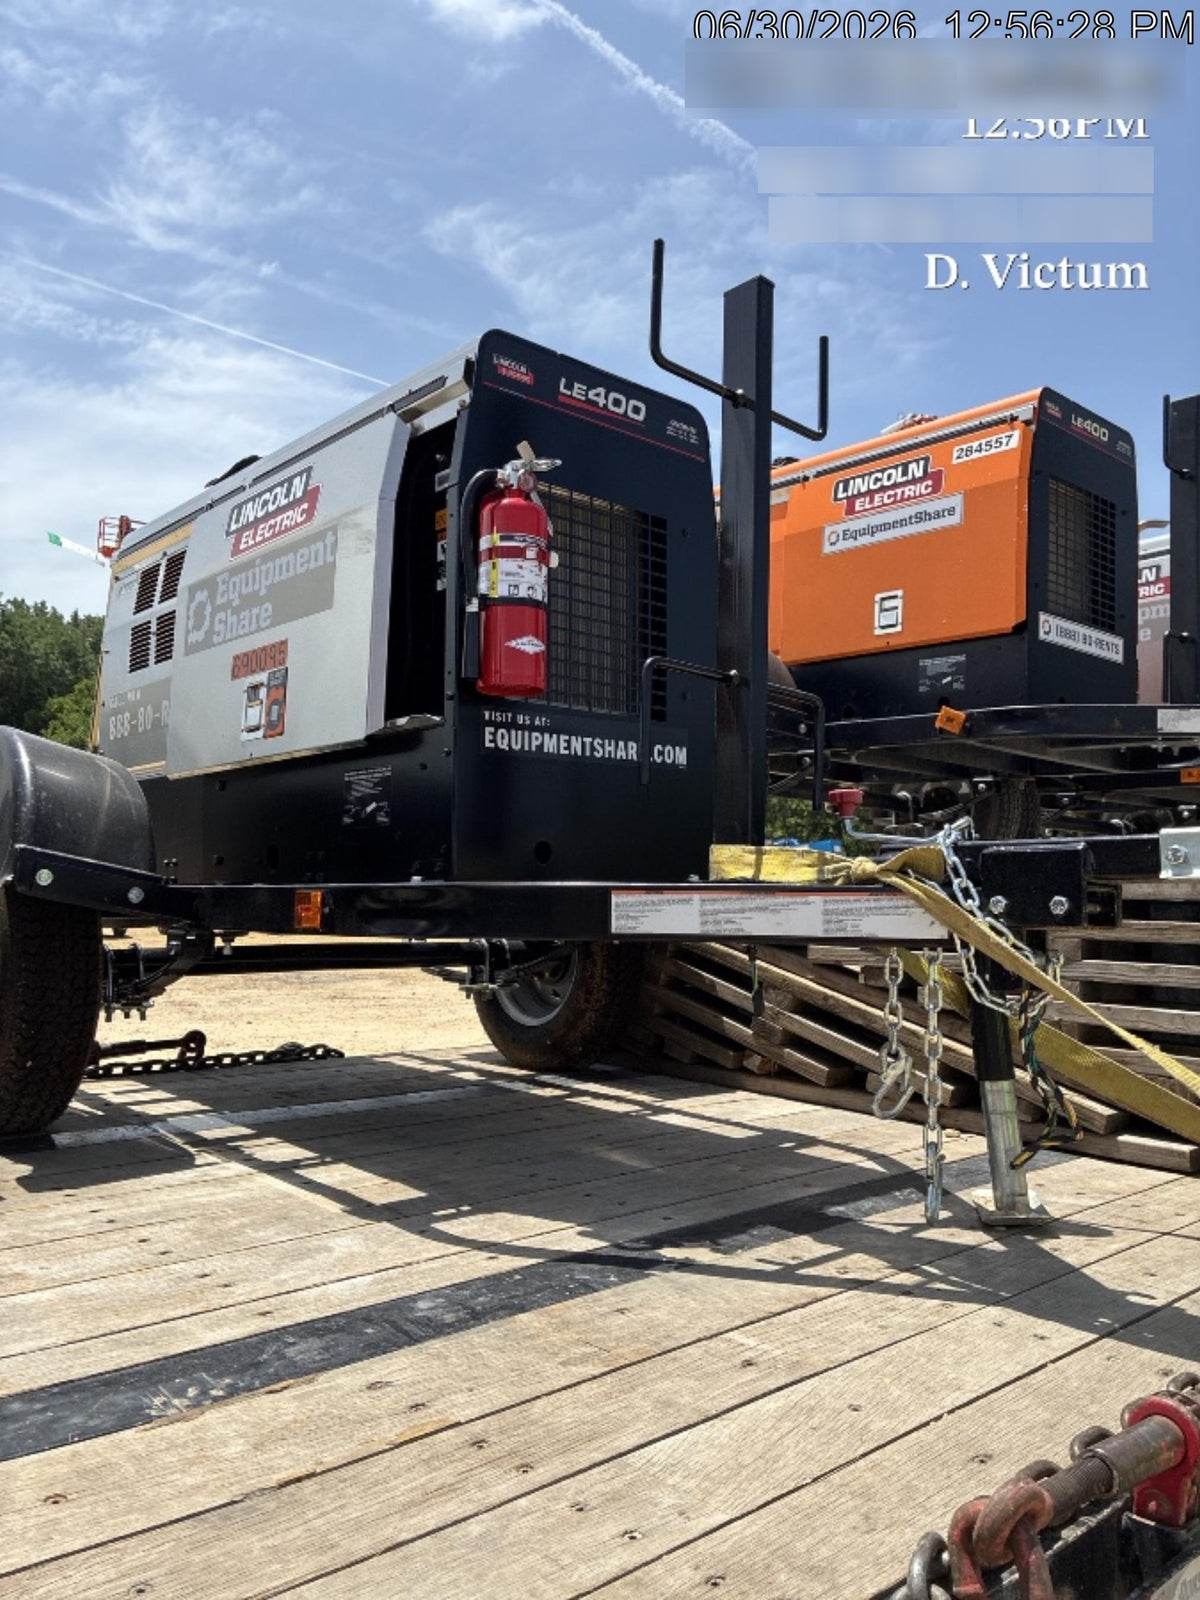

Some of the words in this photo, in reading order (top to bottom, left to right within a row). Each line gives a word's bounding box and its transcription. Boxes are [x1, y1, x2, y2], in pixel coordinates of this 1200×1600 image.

[559, 377, 646, 422] LE400
[955, 433, 1014, 461] 284557
[837, 461, 925, 498] LINCOLN
[855, 480, 933, 512] ELECTRIC
[230, 473, 308, 531] LINCOLN
[240, 502, 308, 550] ELECTRIC
[842, 505, 956, 541] EquipmentShare
[216, 530, 337, 606] Equipment
[213, 601, 273, 644] Share
[483, 710, 512, 722] VISIT
[516, 714, 531, 725] US
[534, 716, 550, 727] AT:
[484, 726, 687, 766] EQUIPMENTSHAR.COM
